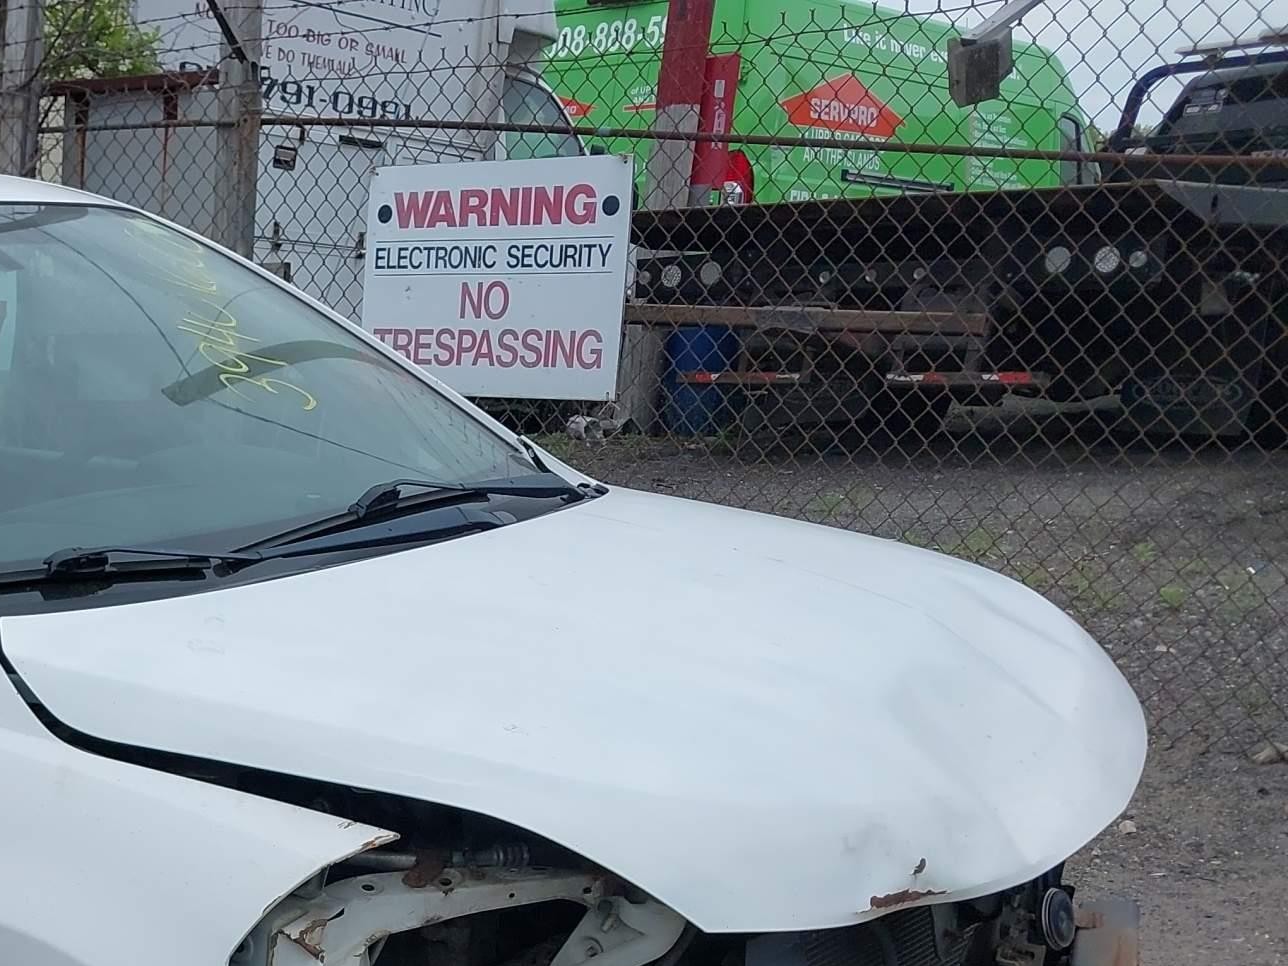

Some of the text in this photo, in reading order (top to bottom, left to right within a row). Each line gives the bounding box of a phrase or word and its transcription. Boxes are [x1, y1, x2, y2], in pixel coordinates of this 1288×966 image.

[267, 19, 299, 38] TOO
[306, 28, 331, 46] BIG
[338, 36, 359, 52] OR
[365, 42, 407, 64] SMALL
[278, 47, 295, 63] DO
[875, 30, 886, 50] it
[890, 40, 926, 60] never
[810, 97, 879, 127] SERVPRO
[394, 183, 597, 229] WARNING
[374, 243, 612, 270] ELECTRONIC SECURITY
[460, 280, 509, 320] NO
[373, 328, 603, 370] TRESPASSING
